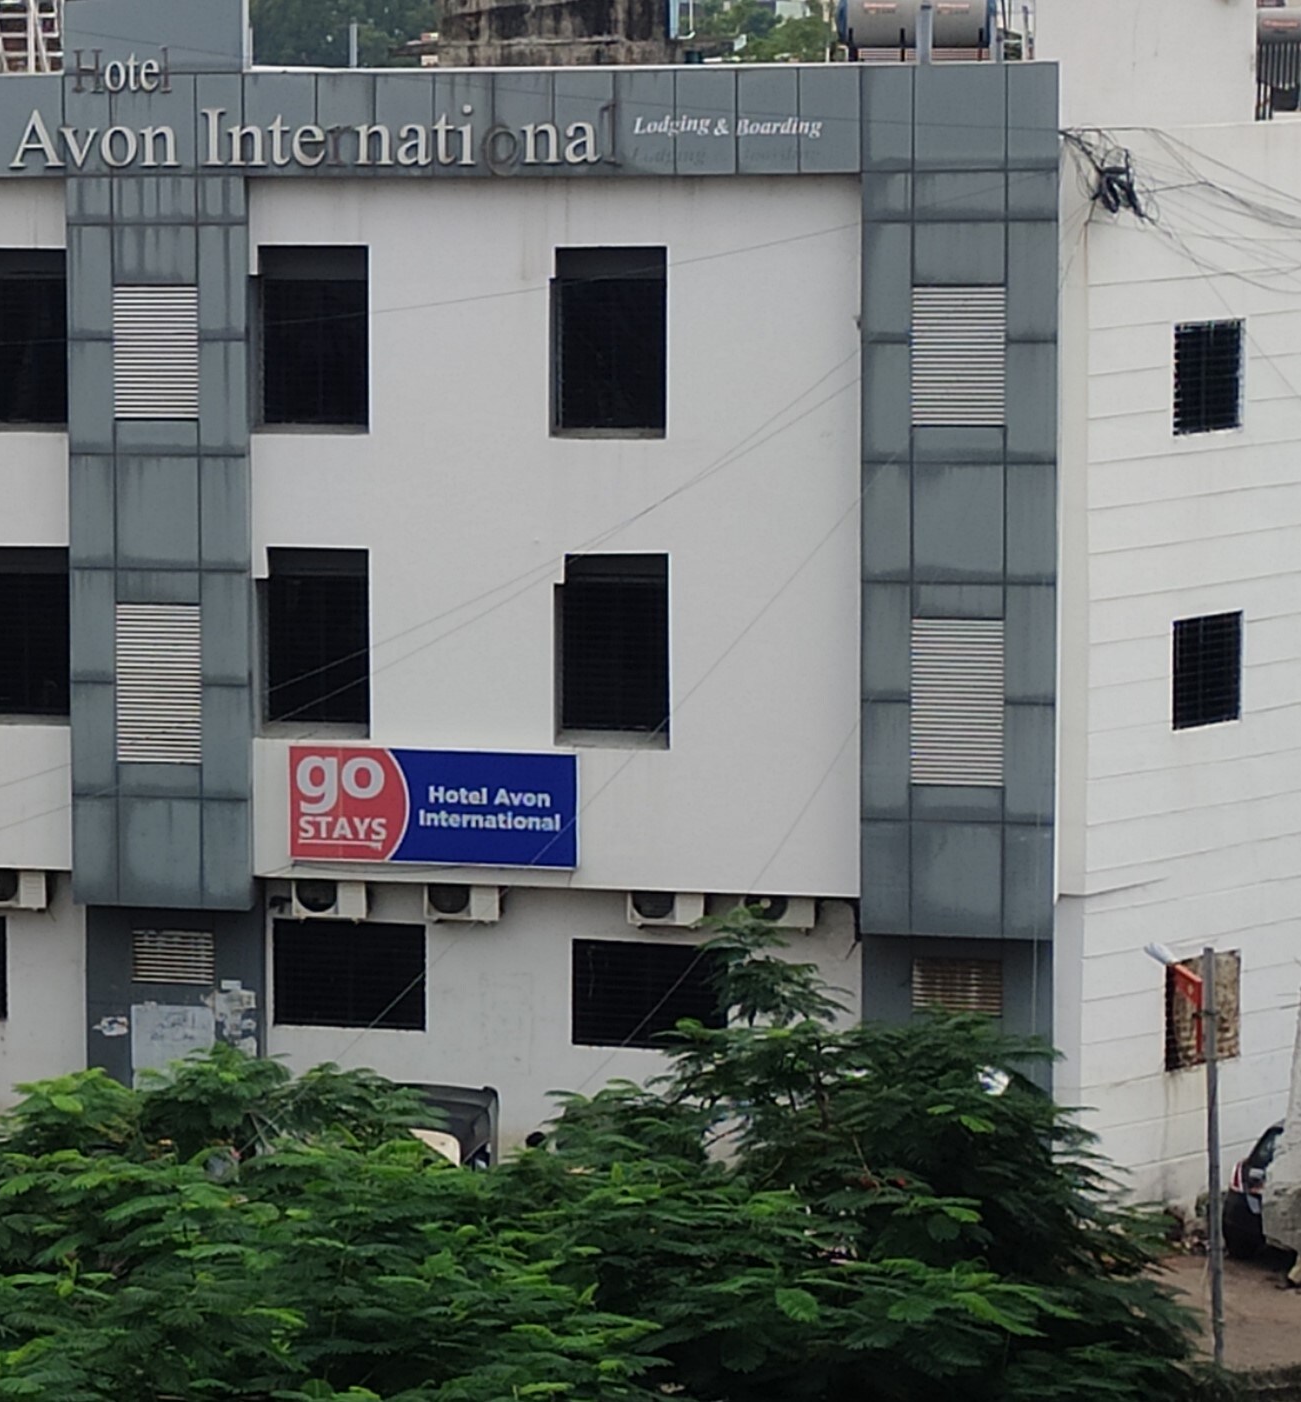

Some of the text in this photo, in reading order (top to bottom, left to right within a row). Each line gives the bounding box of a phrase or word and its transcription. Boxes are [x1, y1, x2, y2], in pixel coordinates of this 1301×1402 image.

[8, 109, 181, 169] Avon
[633, 114, 823, 139] Lodging & Boarding
[295, 755, 386, 815] go
[428, 785, 551, 808] Hotel Avon
[299, 815, 387, 841] STAYS
[418, 808, 561, 832] International
